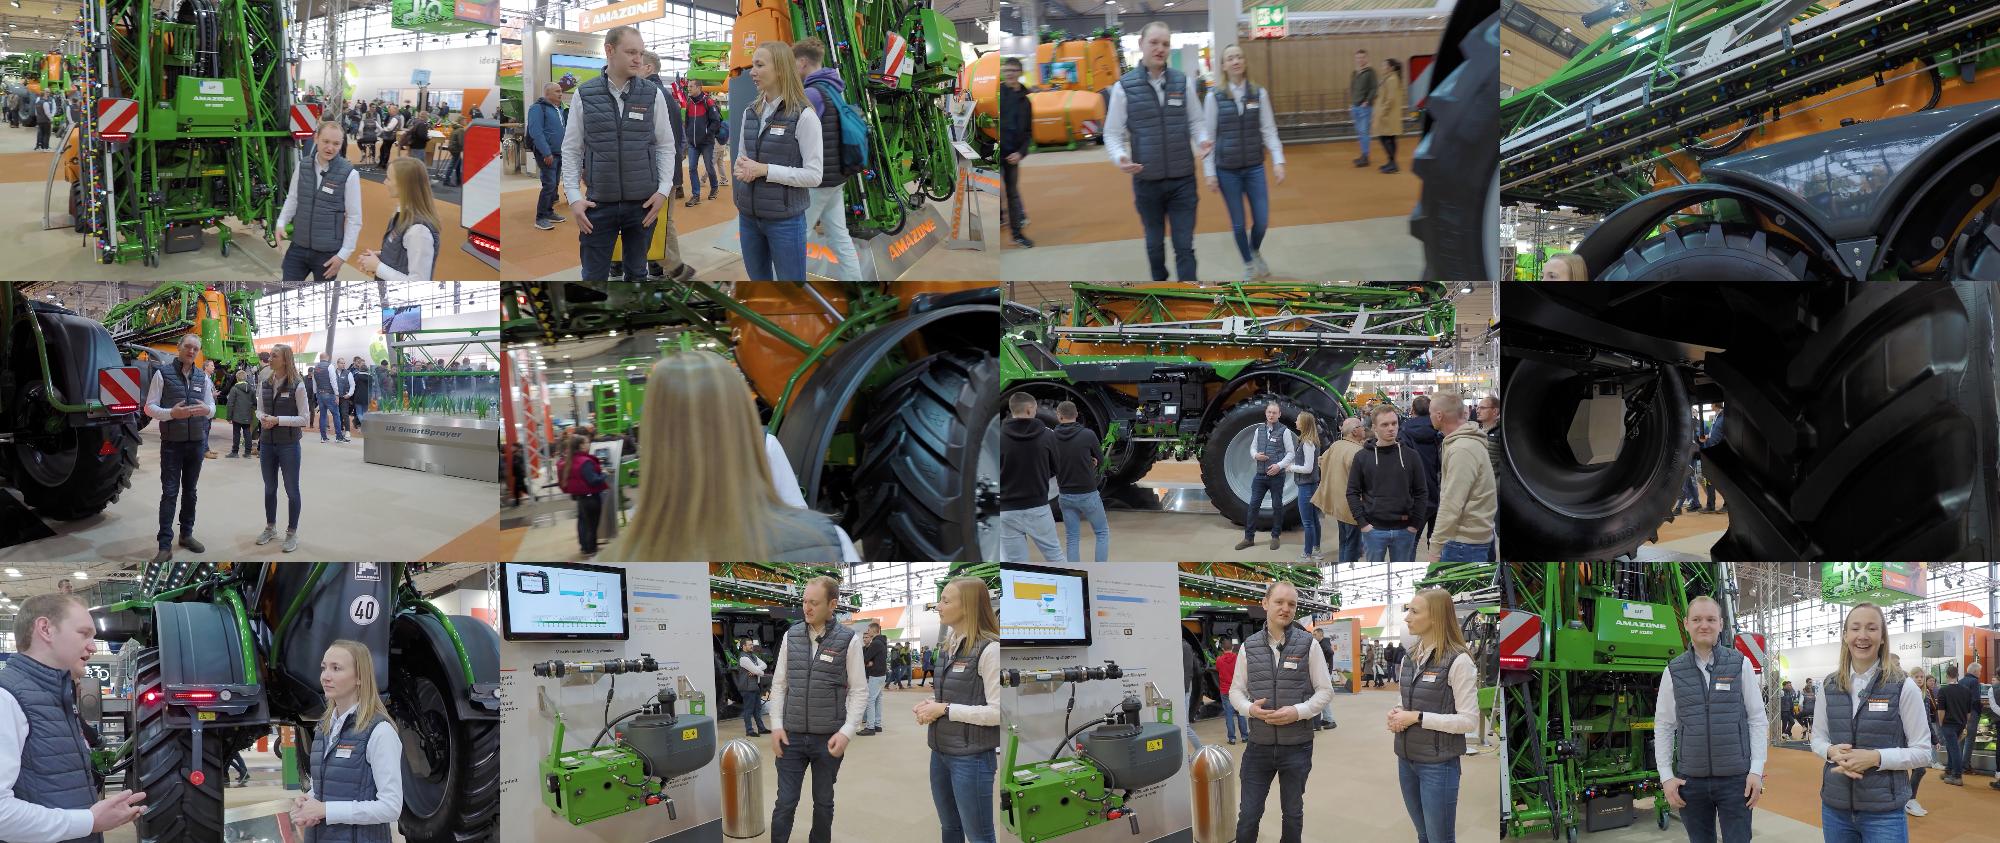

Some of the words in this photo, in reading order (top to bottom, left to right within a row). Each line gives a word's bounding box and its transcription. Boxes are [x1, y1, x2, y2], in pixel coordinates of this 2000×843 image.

[593, 1, 658, 25] AMAZONE
[888, 217, 936, 262] AMAZONE
[398, 426, 462, 438] SmartSprayer
[354, 600, 375, 620] 40
[1615, 619, 1667, 635] AMAZONE
